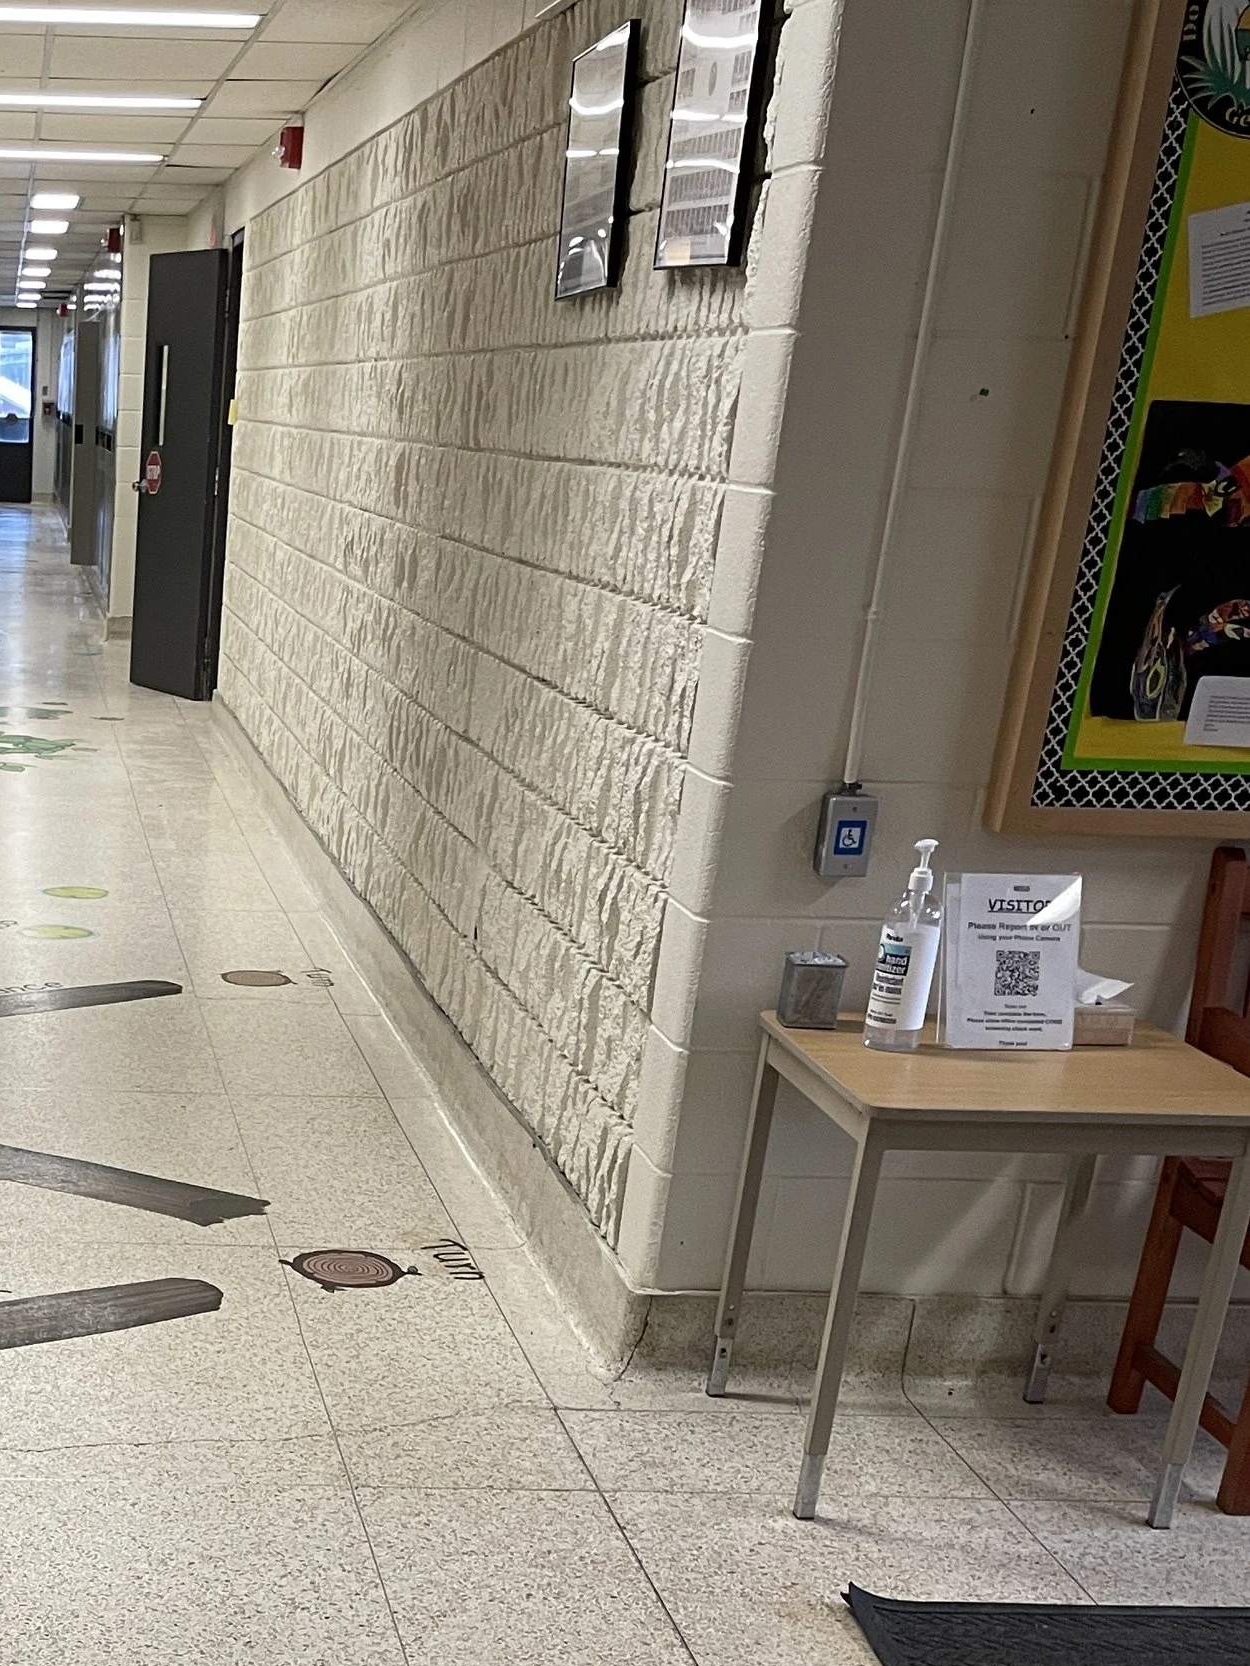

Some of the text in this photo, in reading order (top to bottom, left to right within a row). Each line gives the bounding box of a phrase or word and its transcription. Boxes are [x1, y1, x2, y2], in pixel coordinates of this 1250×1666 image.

[988, 898, 1052, 914] VISITO
[968, 922, 996, 930] Please
[998, 922, 1027, 932] Report
[420, 1238, 486, 1281] Turn
